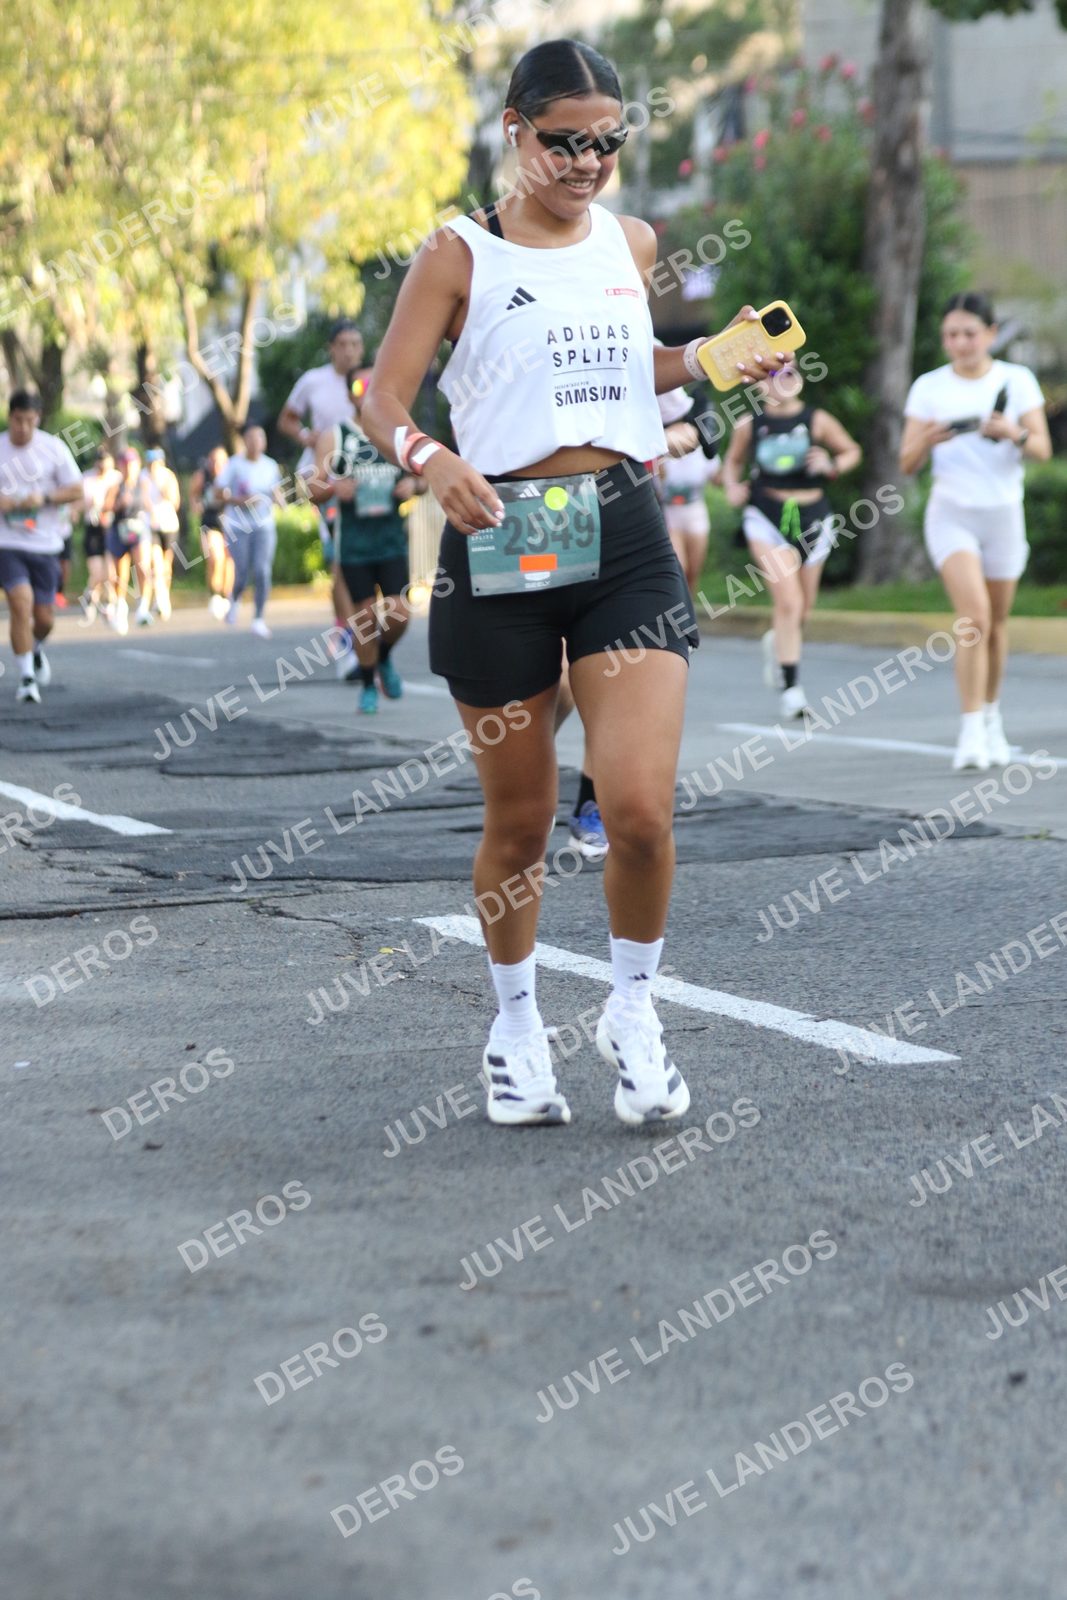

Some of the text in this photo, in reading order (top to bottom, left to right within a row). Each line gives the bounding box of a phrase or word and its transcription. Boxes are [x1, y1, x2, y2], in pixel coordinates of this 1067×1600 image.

[547, 324, 629, 345] ADIDAS
[553, 347, 628, 367] SPLITS
[502, 515, 594, 556] 2549
